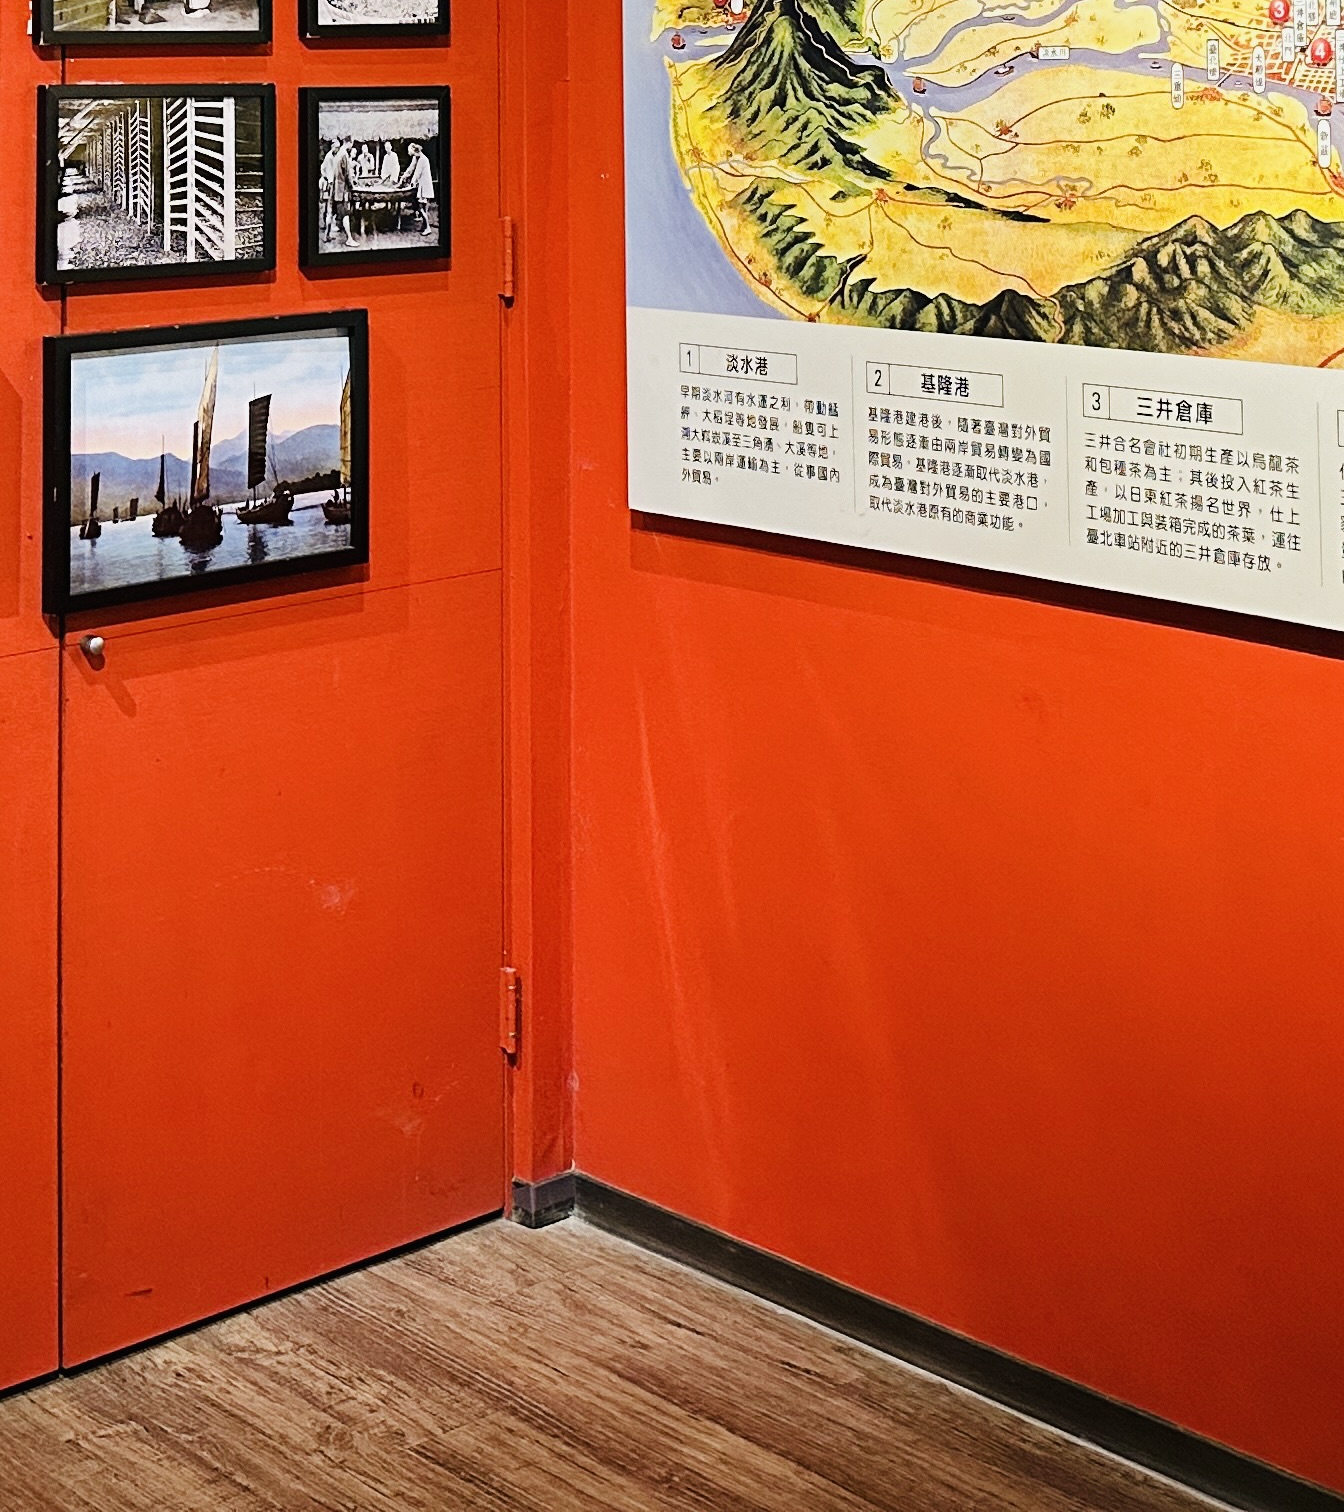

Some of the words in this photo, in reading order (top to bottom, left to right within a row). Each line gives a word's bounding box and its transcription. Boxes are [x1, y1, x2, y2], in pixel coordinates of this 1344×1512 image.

[1273, 1, 1286, 19] 3
[1314, 44, 1326, 61] 4
[686, 350, 692, 367] 1
[726, 353, 769, 376] 淡水港
[874, 369, 882, 387] 2
[920, 373, 970, 398] 基隆港
[1091, 391, 1101, 411] 3
[1136, 396, 1214, 425] 三井倉庫
